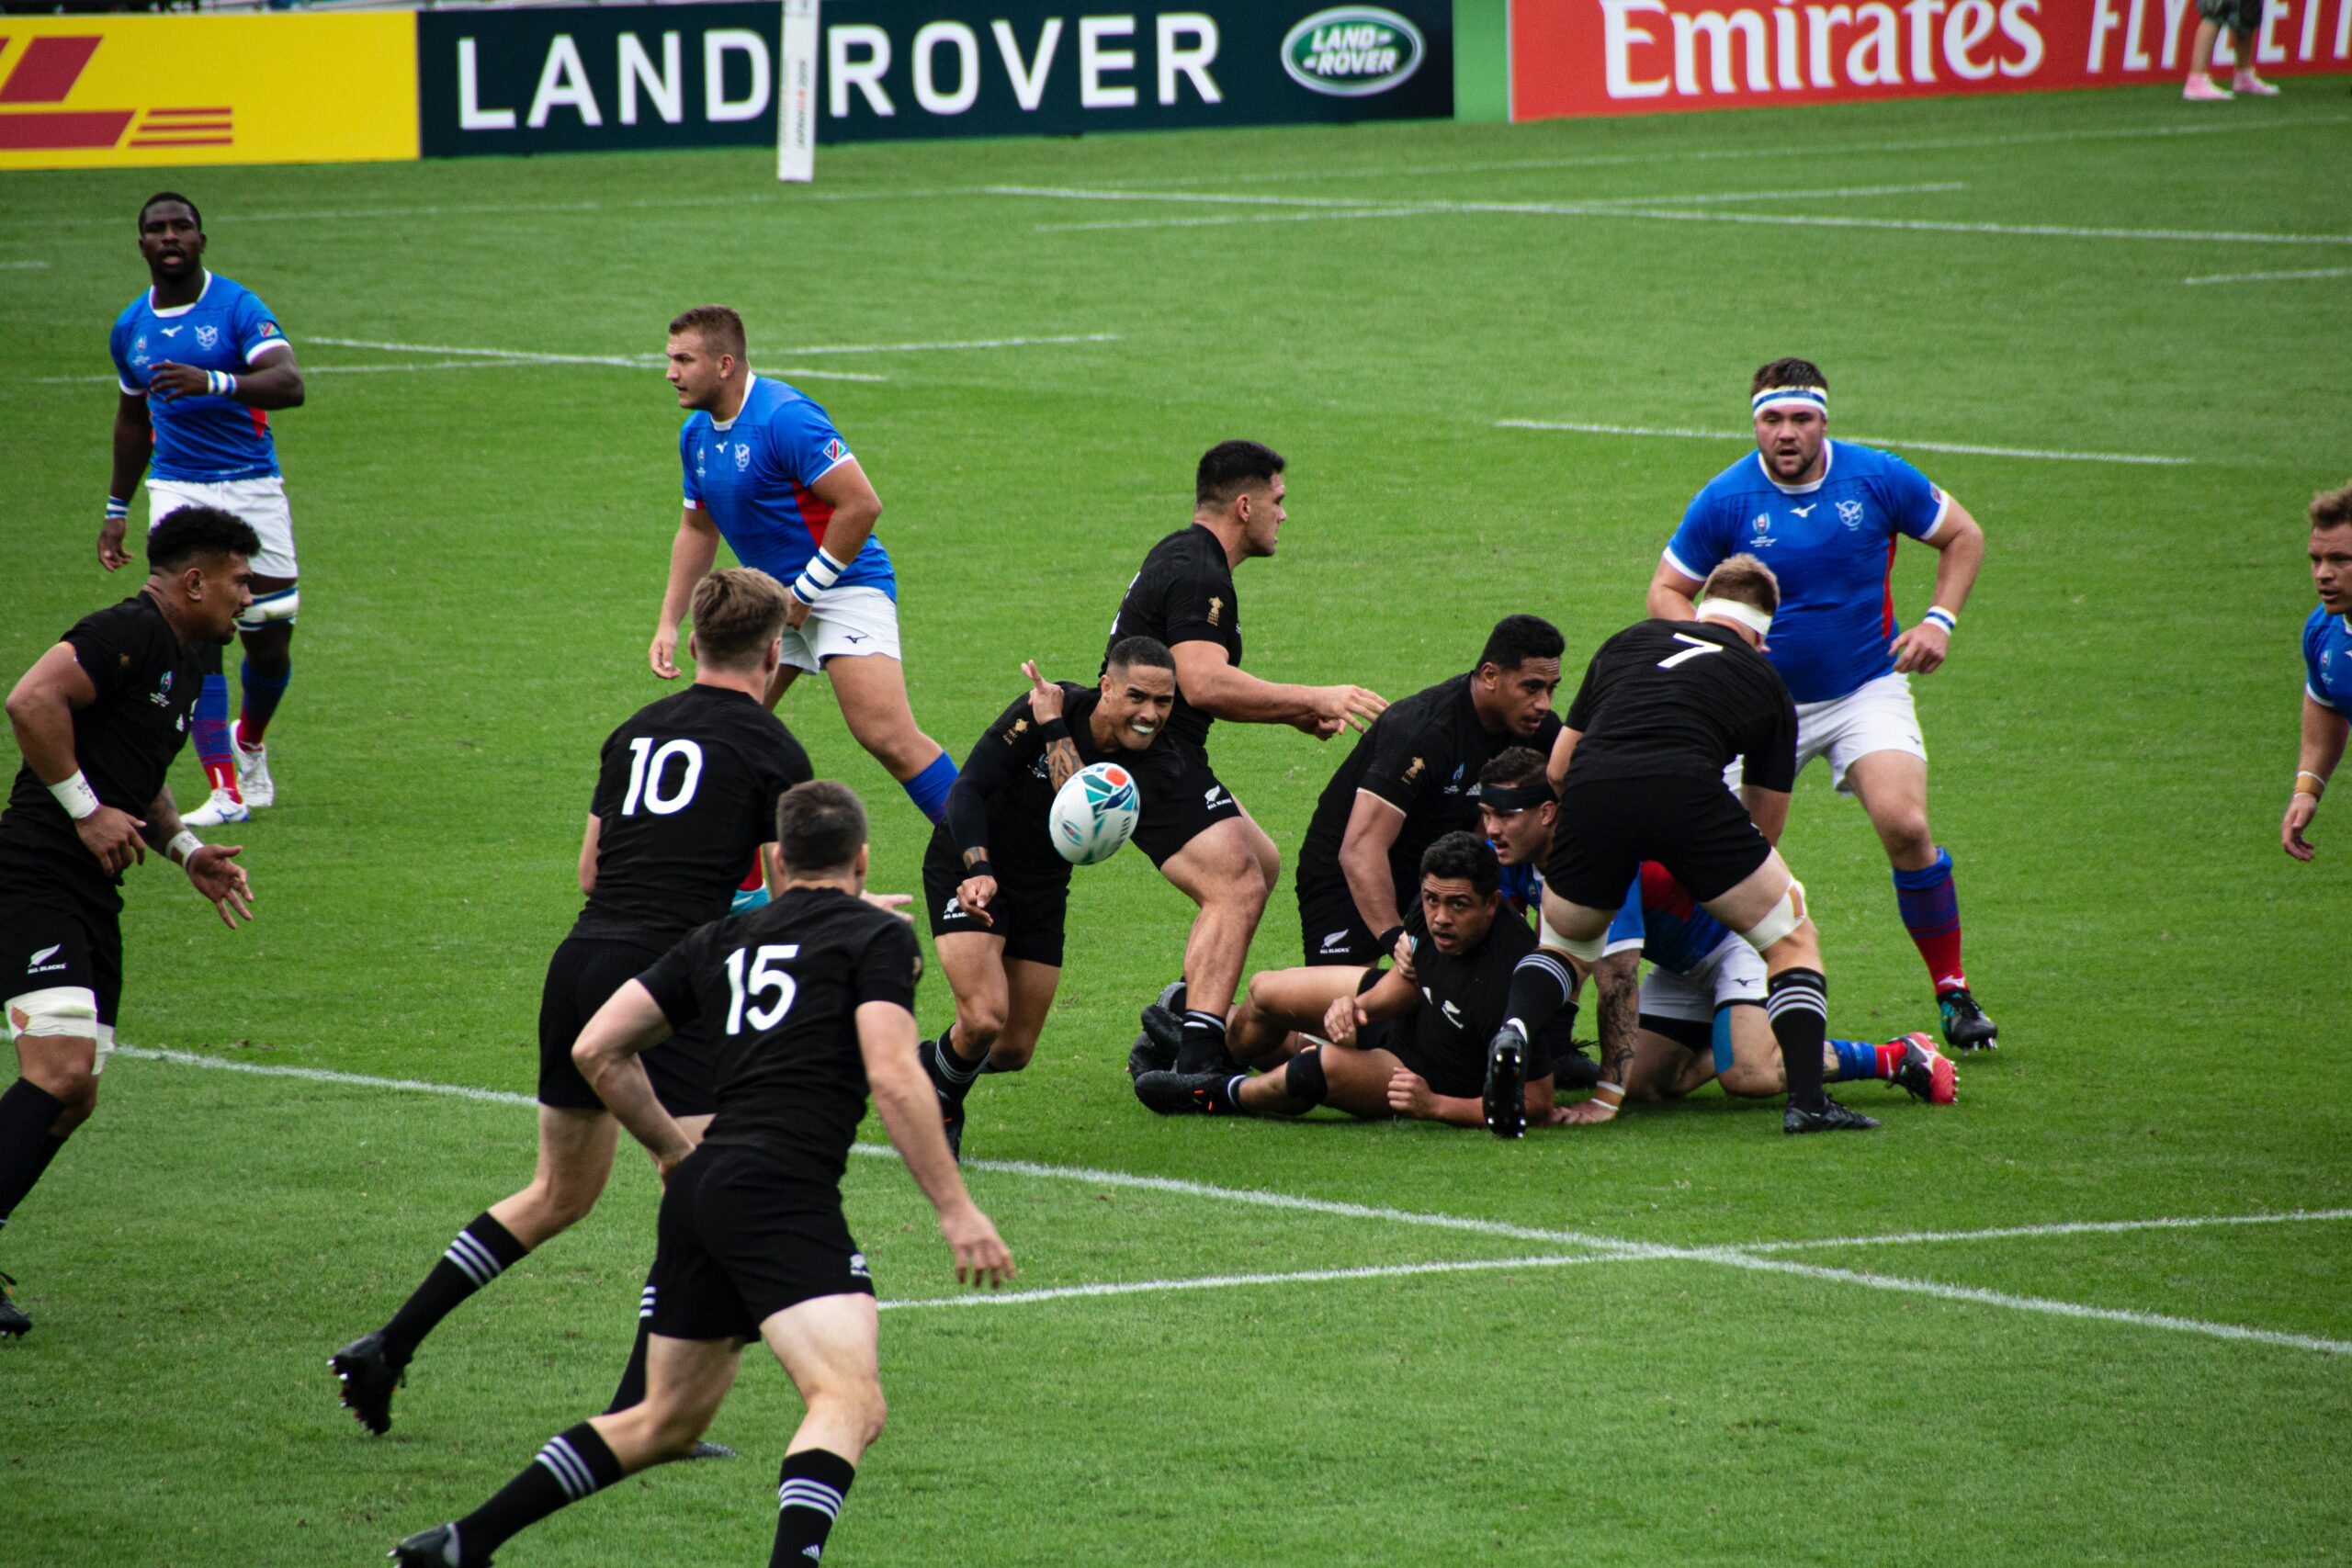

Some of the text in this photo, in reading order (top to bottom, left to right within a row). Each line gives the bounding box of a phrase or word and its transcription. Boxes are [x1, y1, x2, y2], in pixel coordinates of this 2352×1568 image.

[458, 28, 771, 130] LAND
[828, 13, 1224, 118] ROVER
[1311, 25, 1377, 52] LAND
[1316, 47, 1397, 75] ROVER
[1601, 0, 2046, 99] Emirates
[2086, 0, 2190, 73] FLY
[1657, 632, 1724, 669] 7
[621, 737, 704, 816] 10
[724, 943, 800, 1035] 15
